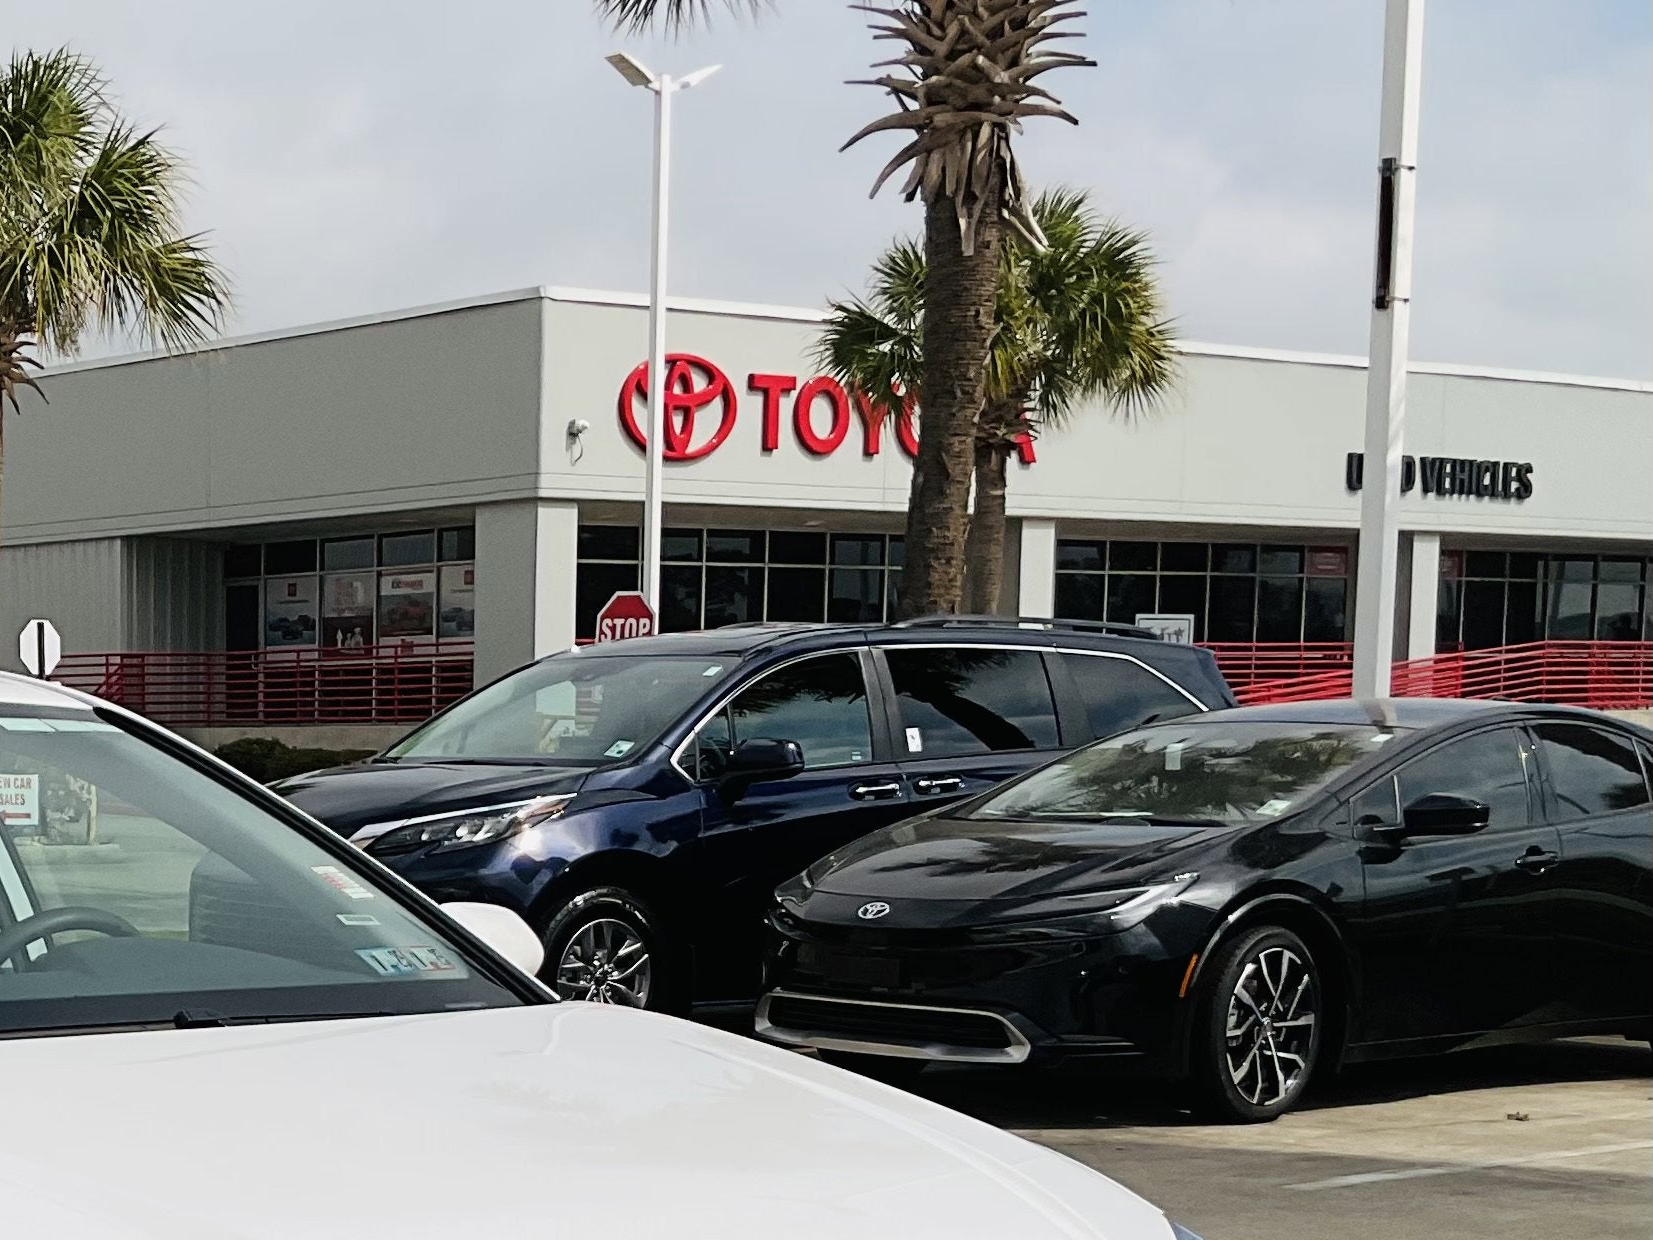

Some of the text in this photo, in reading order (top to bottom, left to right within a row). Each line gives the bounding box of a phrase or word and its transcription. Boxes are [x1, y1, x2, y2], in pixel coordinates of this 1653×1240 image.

[747, 372, 1037, 464] TOY
[1347, 453, 1534, 500] UD VEHICLES
[600, 617, 651, 642] STOP
[13, 776, 32, 790] CAR
[0, 793, 26, 806] SALES
